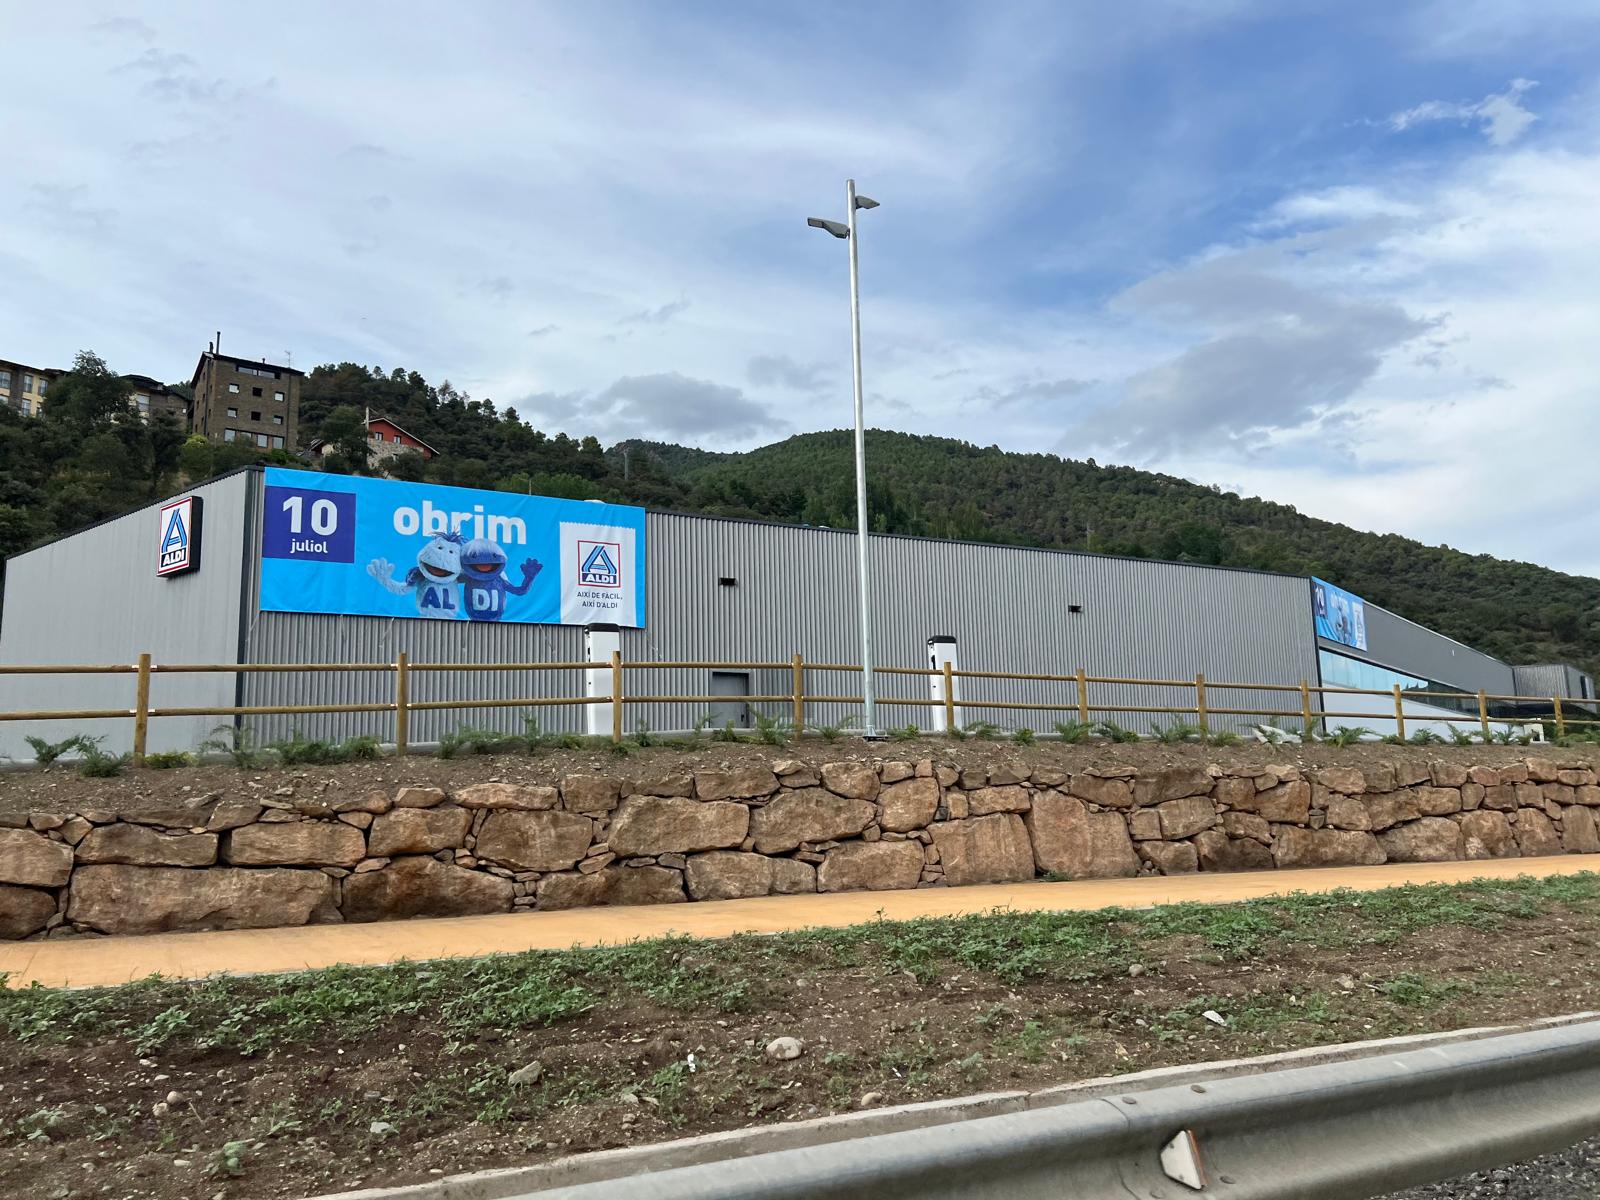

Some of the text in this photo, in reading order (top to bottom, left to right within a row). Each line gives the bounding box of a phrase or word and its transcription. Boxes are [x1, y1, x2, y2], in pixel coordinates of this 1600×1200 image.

[282, 496, 338, 536] 10
[393, 499, 527, 545] obrim
[290, 538, 328, 554] juliol
[162, 549, 185, 566] ALDI
[585, 574, 614, 584] ALDI
[420, 586, 499, 612] AL DI
